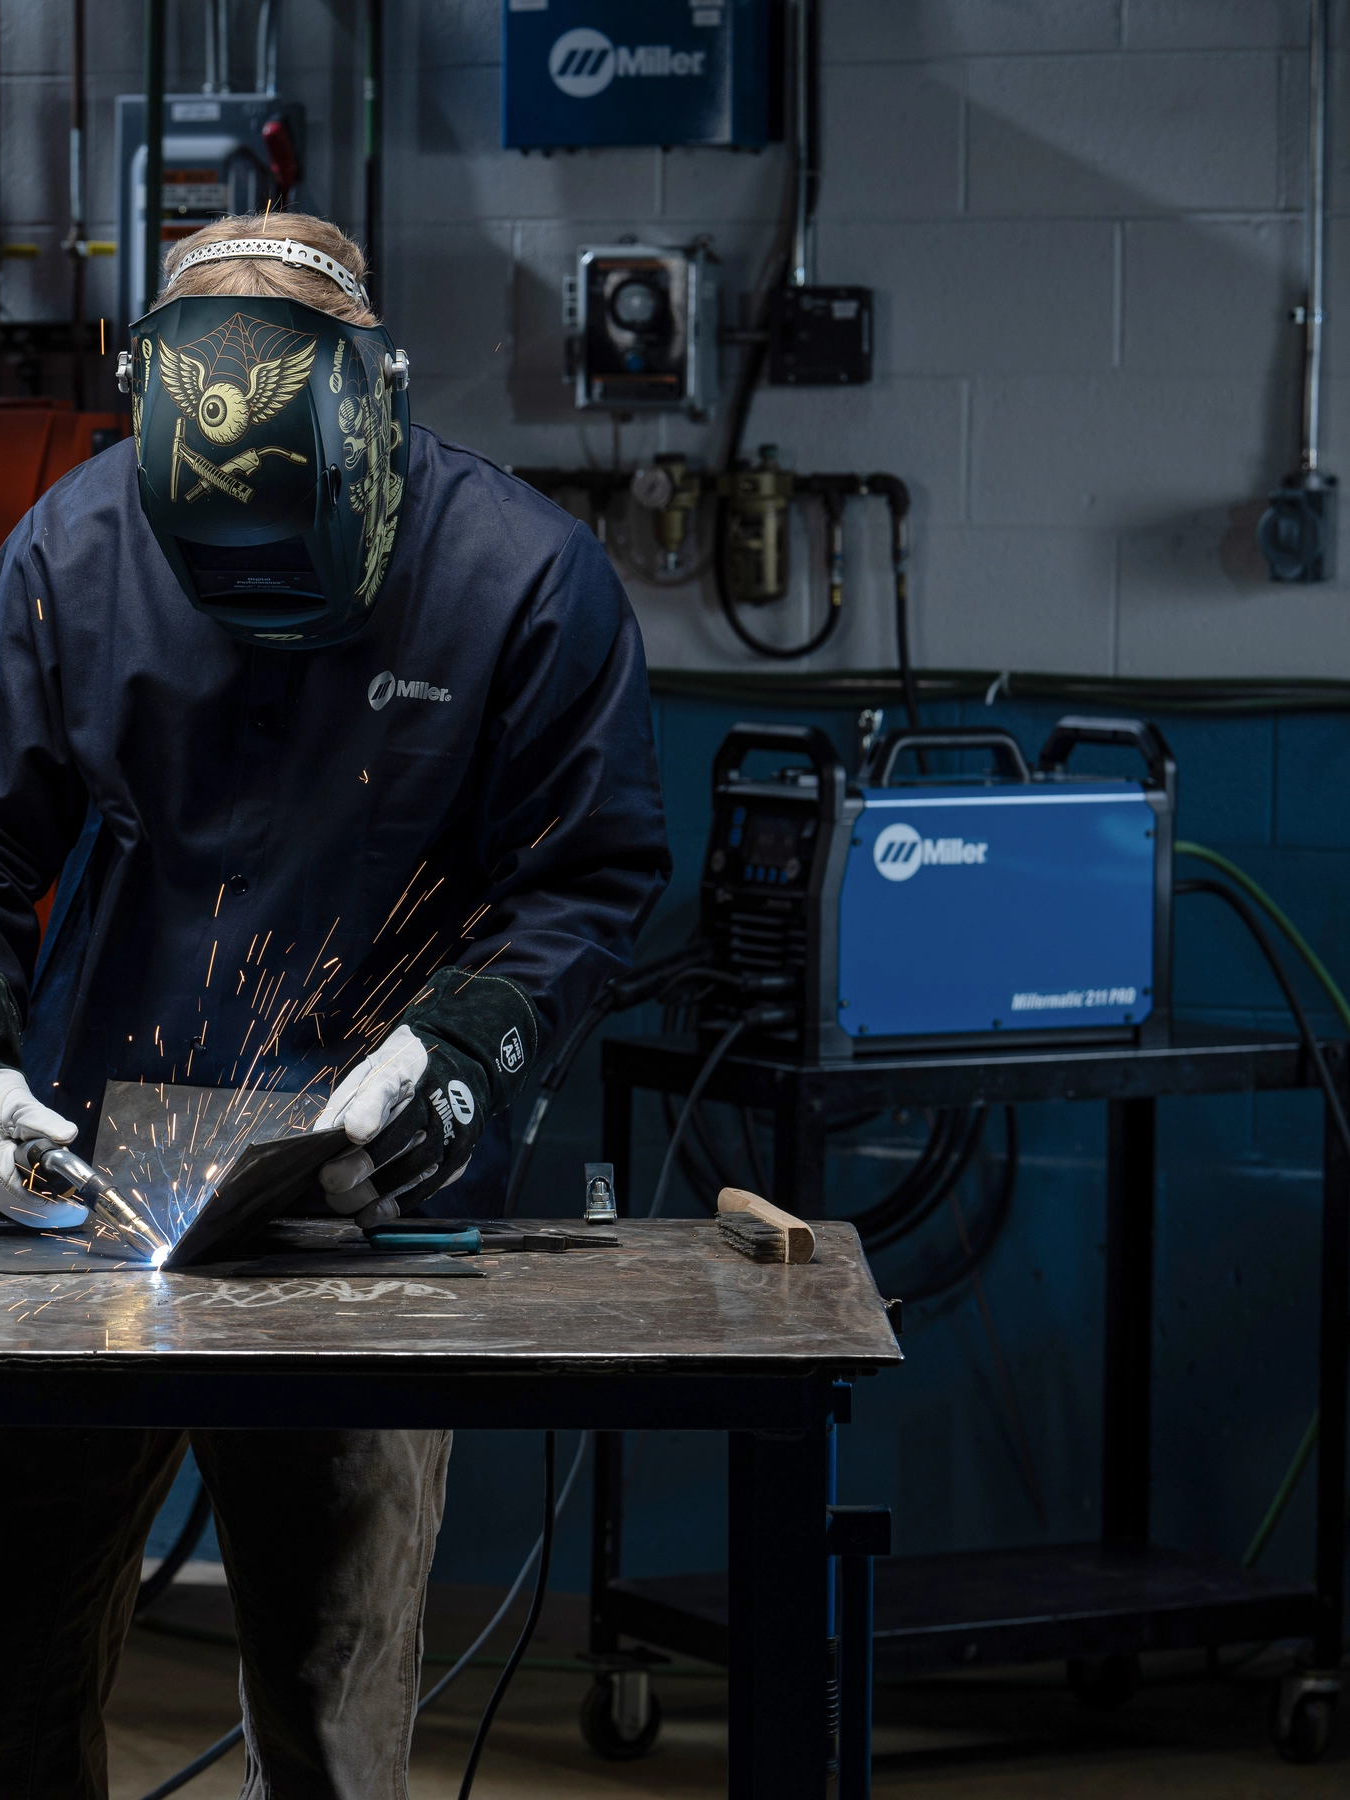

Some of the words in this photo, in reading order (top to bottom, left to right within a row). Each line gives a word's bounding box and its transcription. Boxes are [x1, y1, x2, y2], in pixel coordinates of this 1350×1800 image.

[617, 45, 705, 77] Miller
[922, 837, 989, 866] Miller
[1108, 985, 1137, 1006] PRO
[503, 1043, 518, 1067] A5
